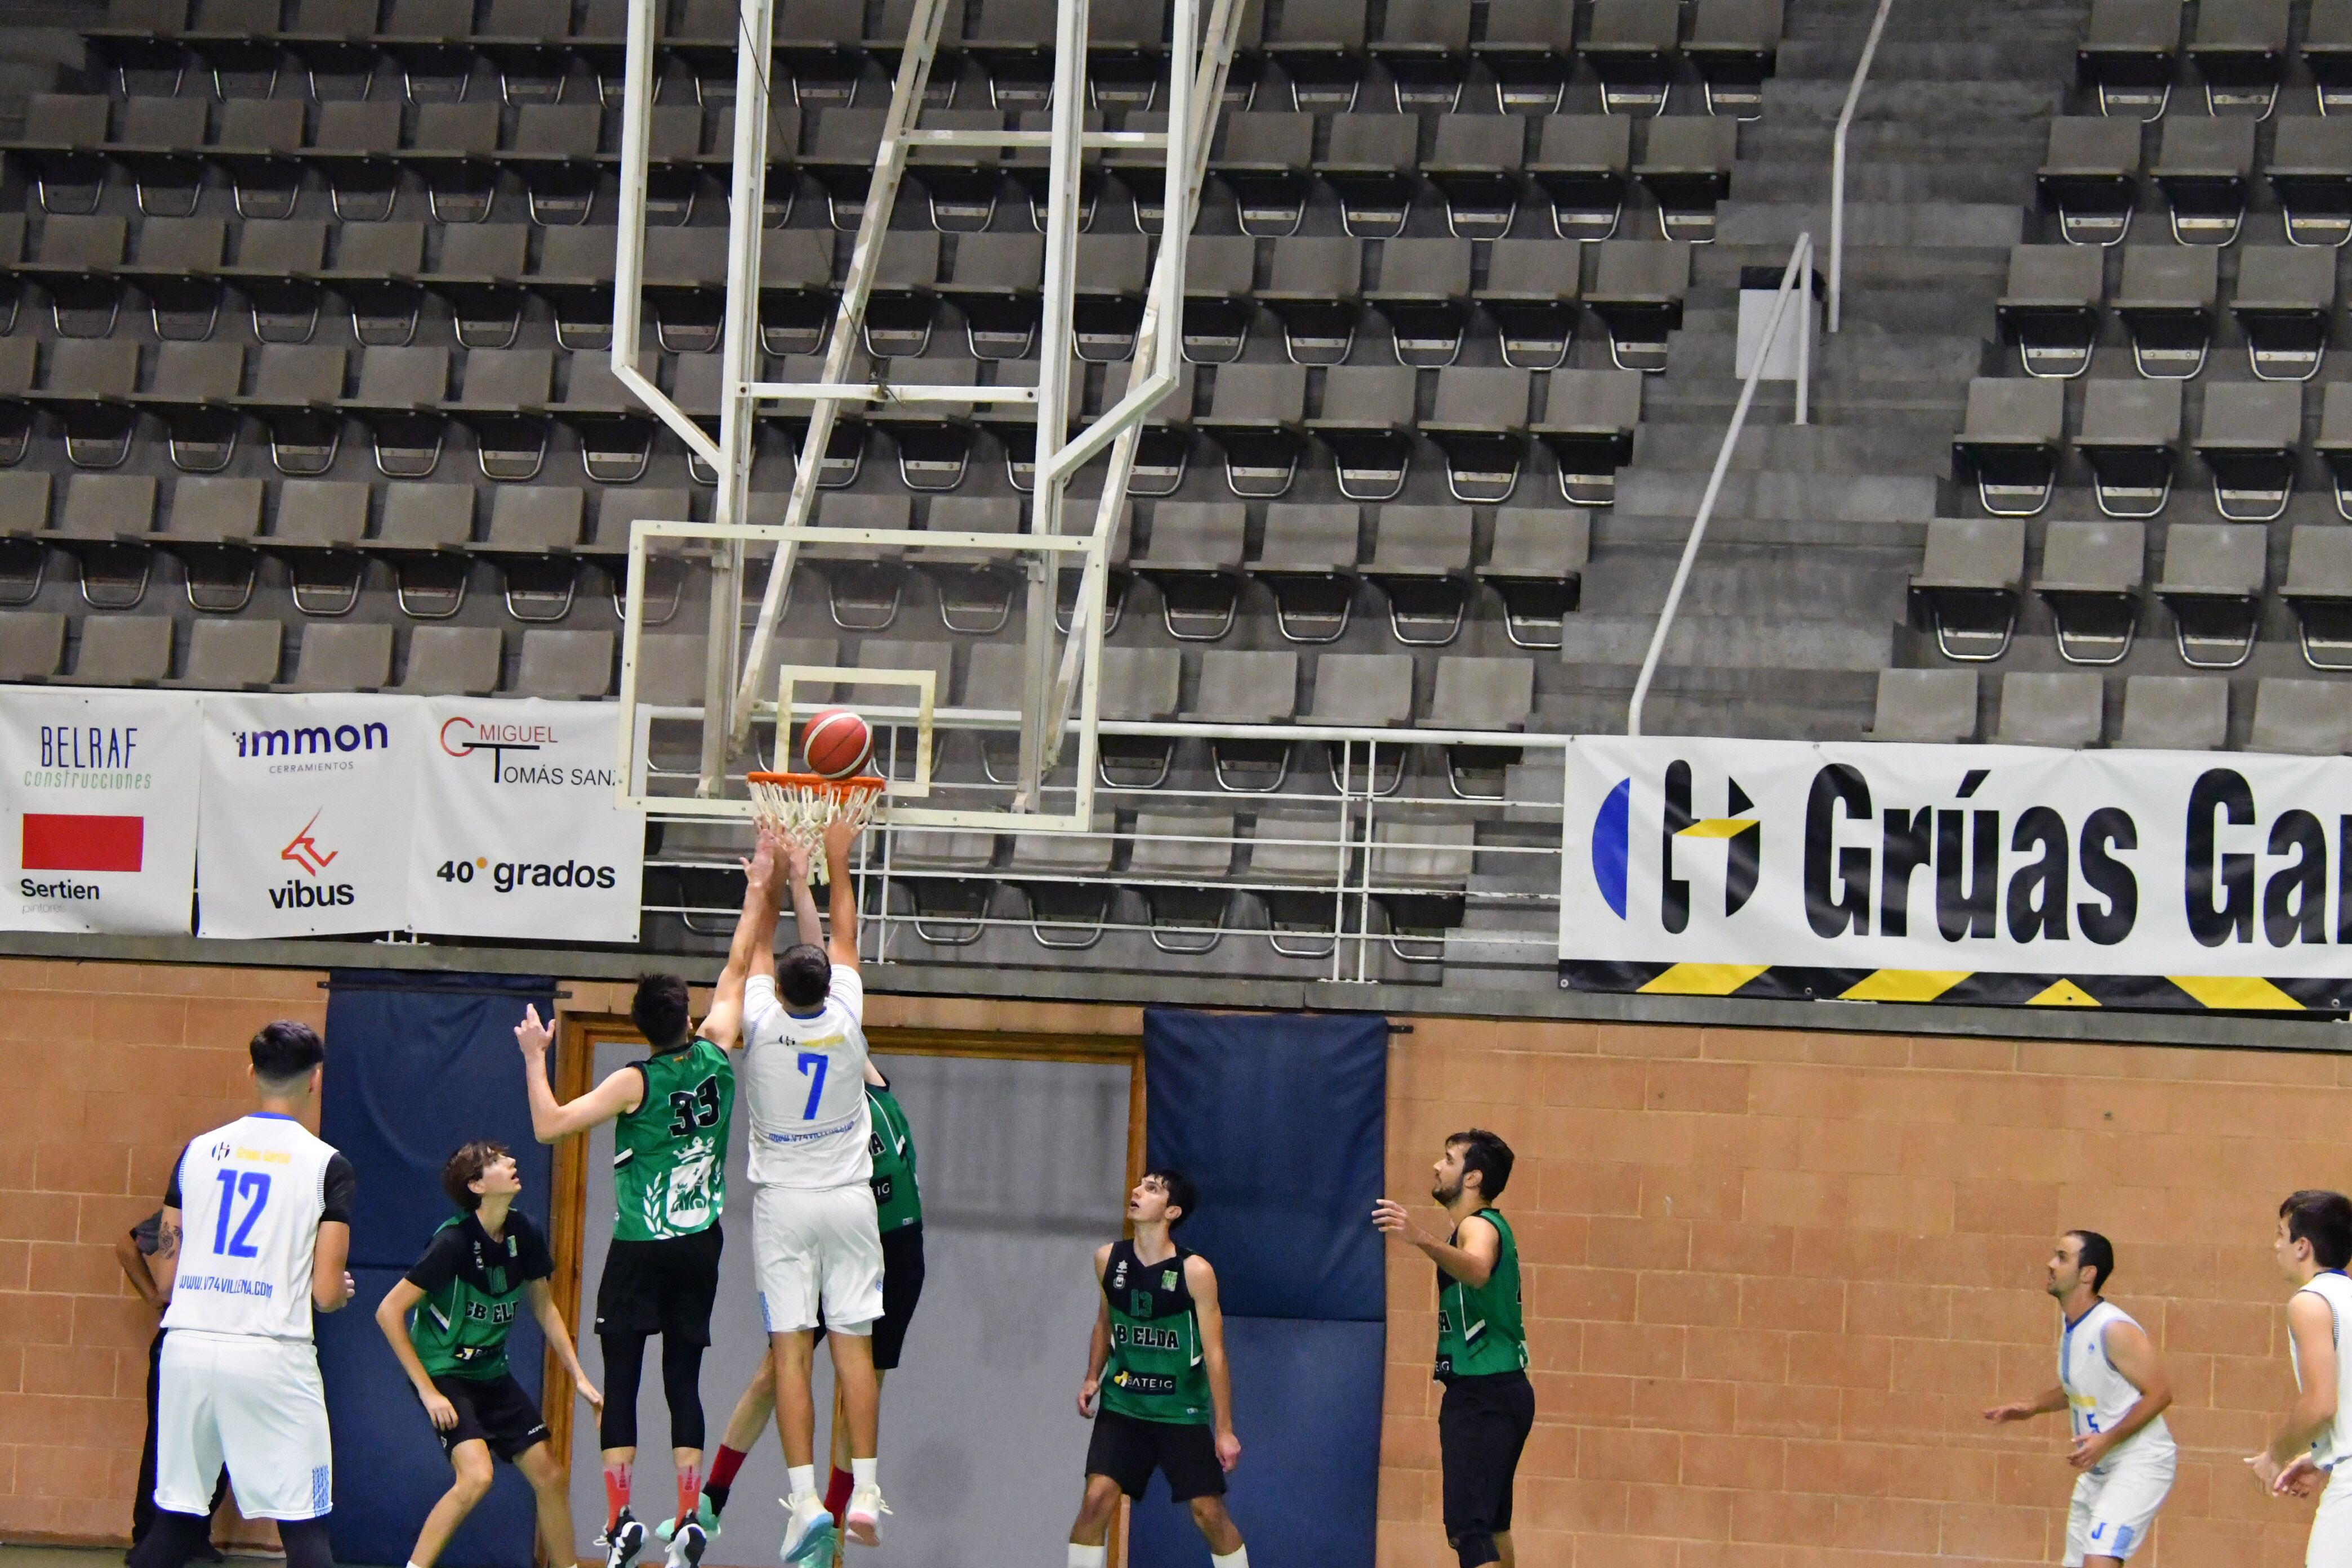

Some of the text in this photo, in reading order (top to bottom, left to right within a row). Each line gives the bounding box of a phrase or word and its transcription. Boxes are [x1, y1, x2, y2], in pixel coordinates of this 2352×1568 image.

[41, 727, 137, 768] BELRAF
[480, 724, 558, 743] MIGUEL
[24, 769, 152, 790] construcciones
[269, 761, 354, 774] CERRAMIENTOS
[1803, 763, 2352, 948] Grúas Ga
[21, 878, 100, 899] Sertien
[493, 860, 615, 893] grados
[269, 880, 355, 908] vibus
[798, 1053, 828, 1120] 7
[668, 1075, 720, 1137] 33
[213, 1168, 271, 1258] 12
[1132, 1326, 1179, 1349] ELDA
